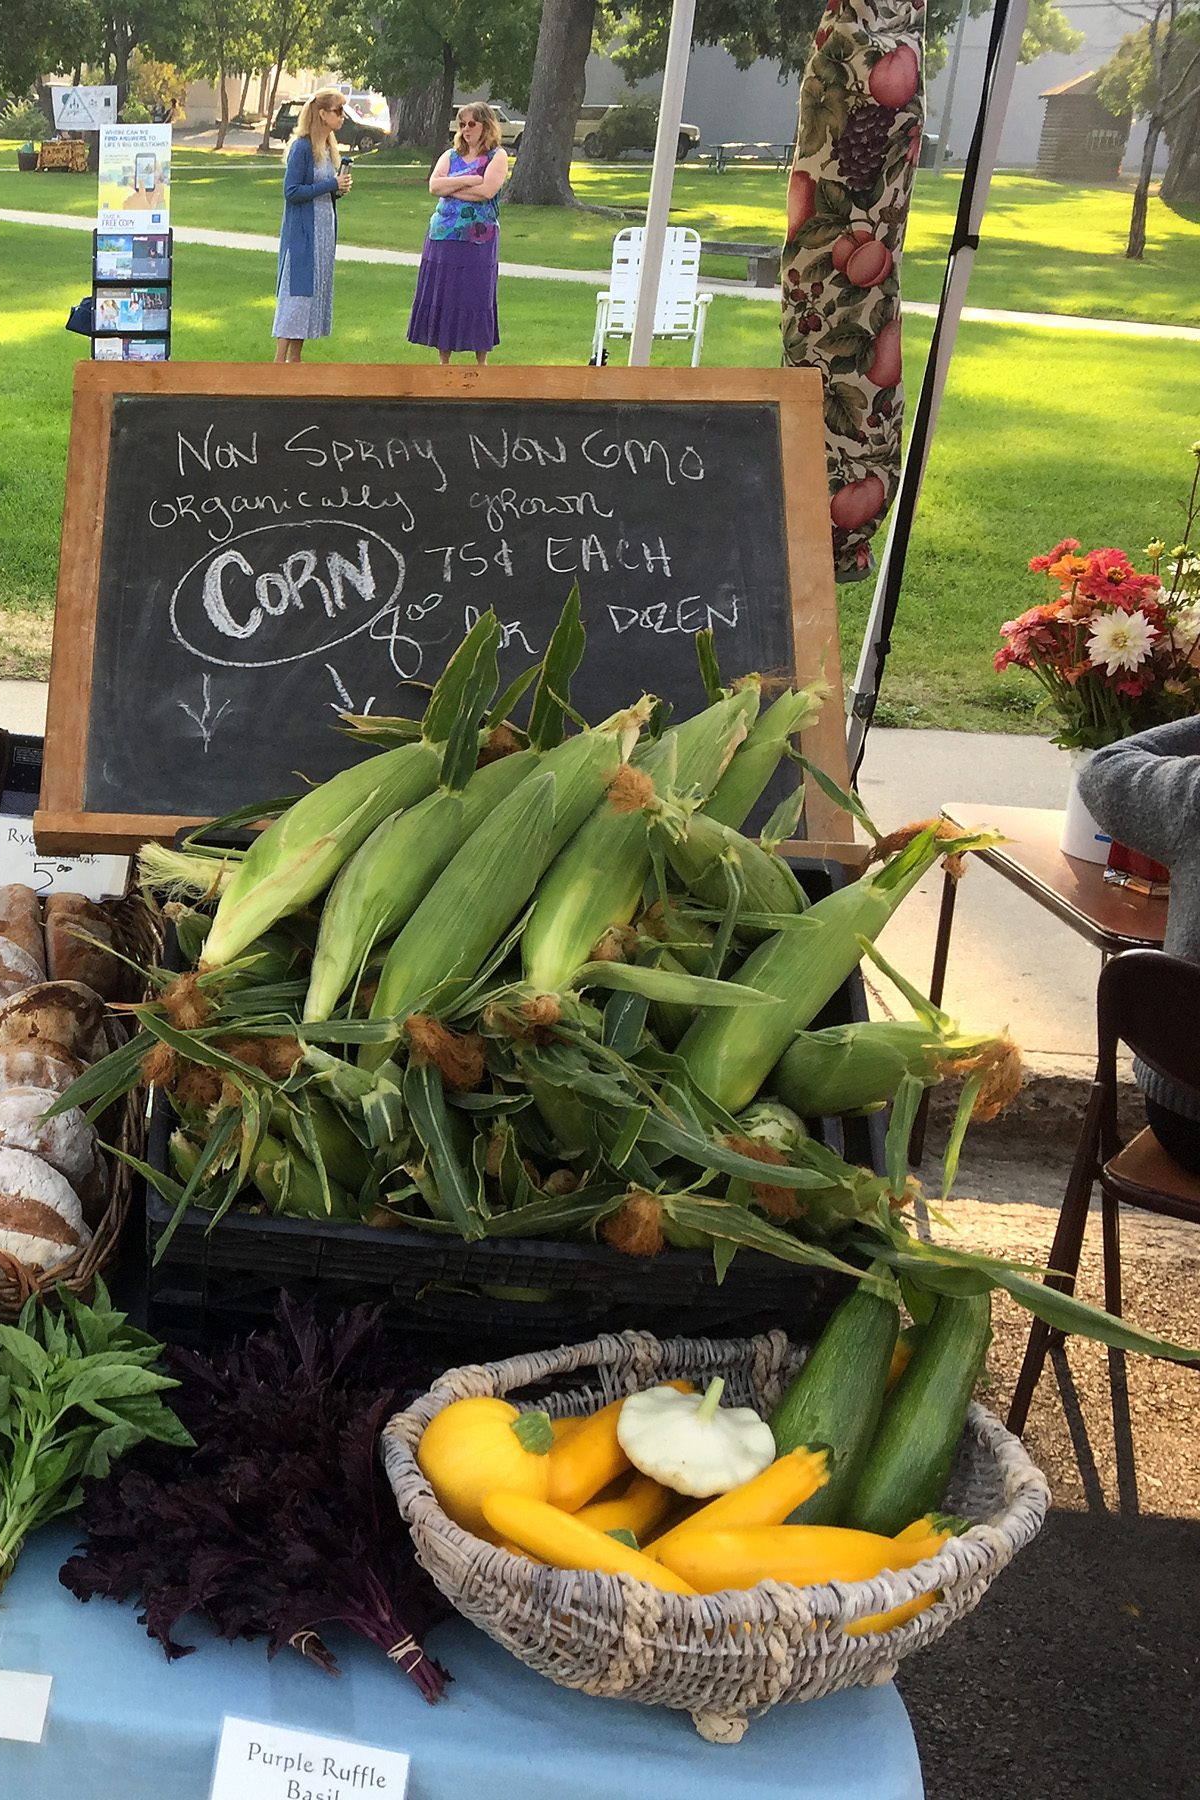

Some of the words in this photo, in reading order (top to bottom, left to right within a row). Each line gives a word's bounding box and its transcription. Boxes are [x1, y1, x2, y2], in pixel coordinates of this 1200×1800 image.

[580, 428, 705, 486] GMO
[545, 533, 672, 578] EACH
[7, 827, 36, 846] Rye
[248, 1742, 314, 1773] Purple
[322, 1757, 387, 1789] Ruffle
[287, 1779, 341, 1800] Basil
